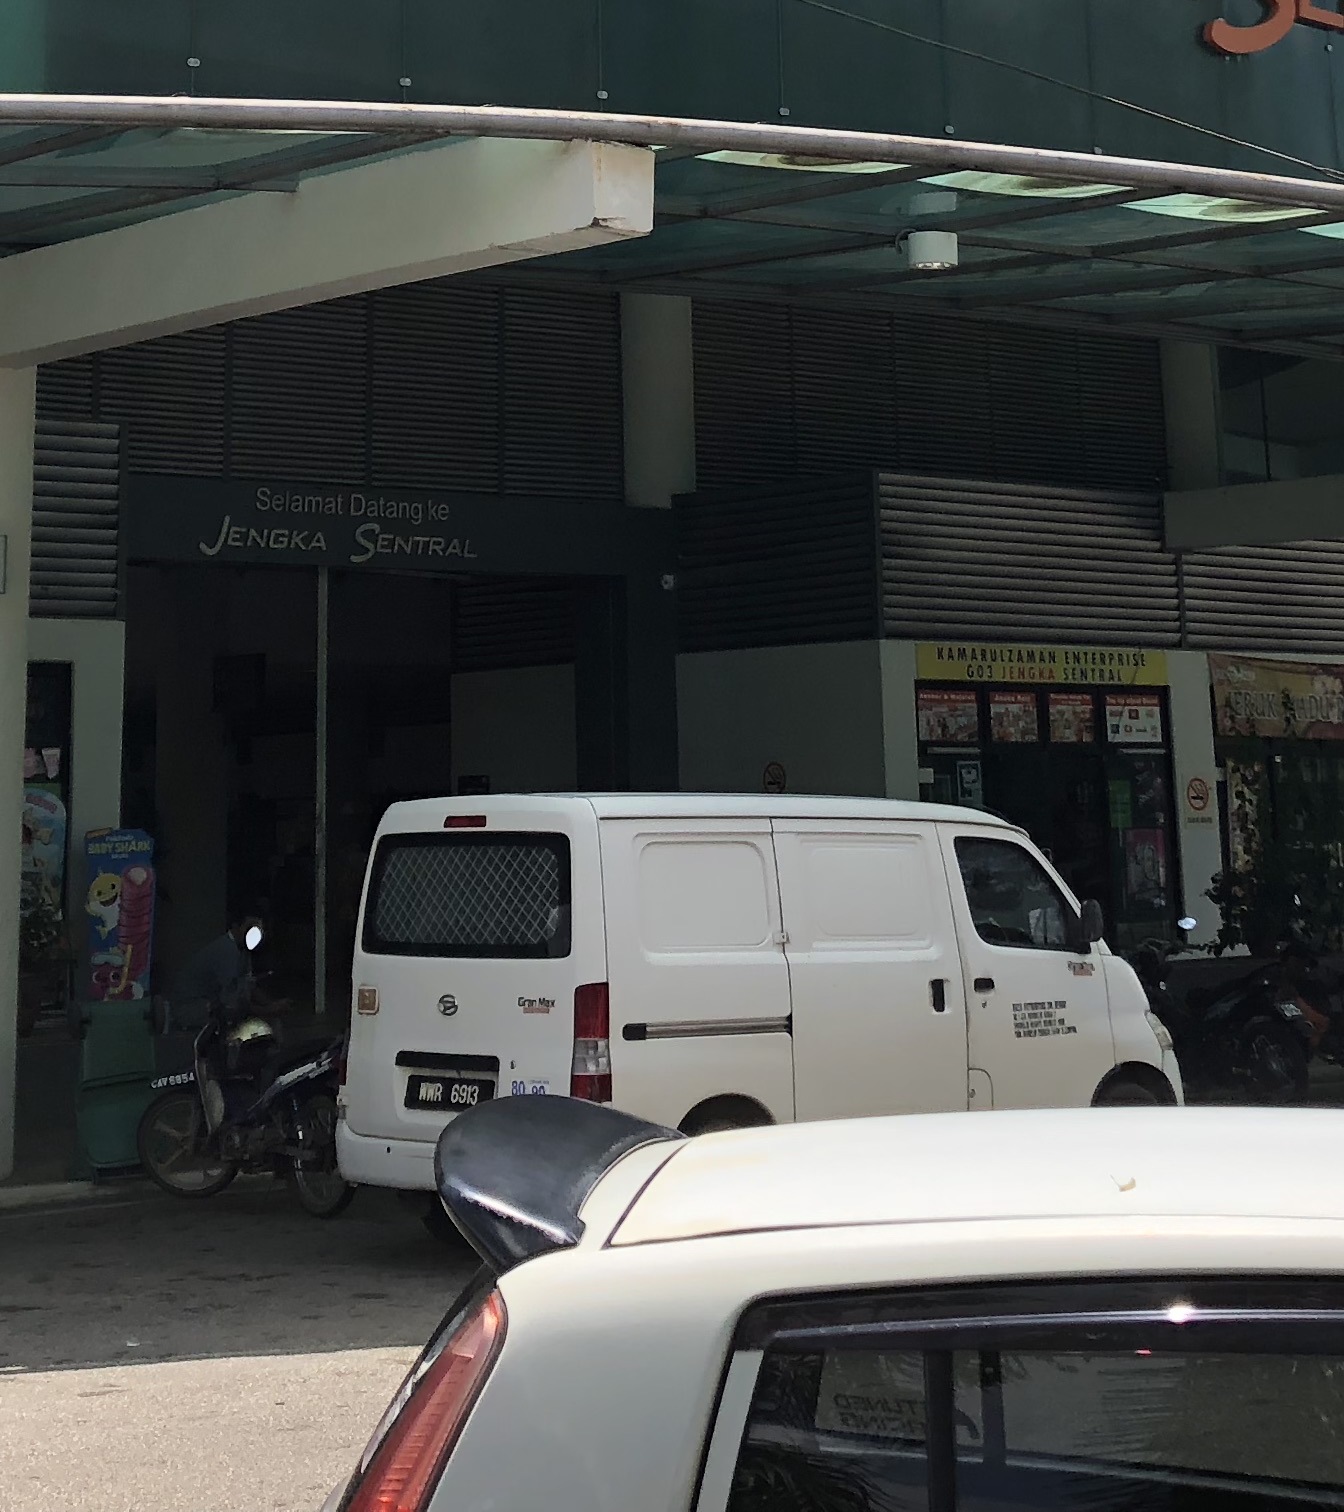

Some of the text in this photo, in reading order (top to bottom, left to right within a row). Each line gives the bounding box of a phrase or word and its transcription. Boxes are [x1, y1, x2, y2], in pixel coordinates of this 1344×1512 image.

[255, 486, 450, 525] Selamat Datang ke
[199, 515, 478, 563] JENGKA SENTRAL
[937, 646, 1147, 668] KAMARULZAMAN ENTERPRISE
[1001, 665, 1056, 681] JENGKA
[1062, 667, 1123, 682] SENTRAL
[517, 996, 555, 1008] Gran Max
[418, 1082, 479, 1106] WWR 6913
